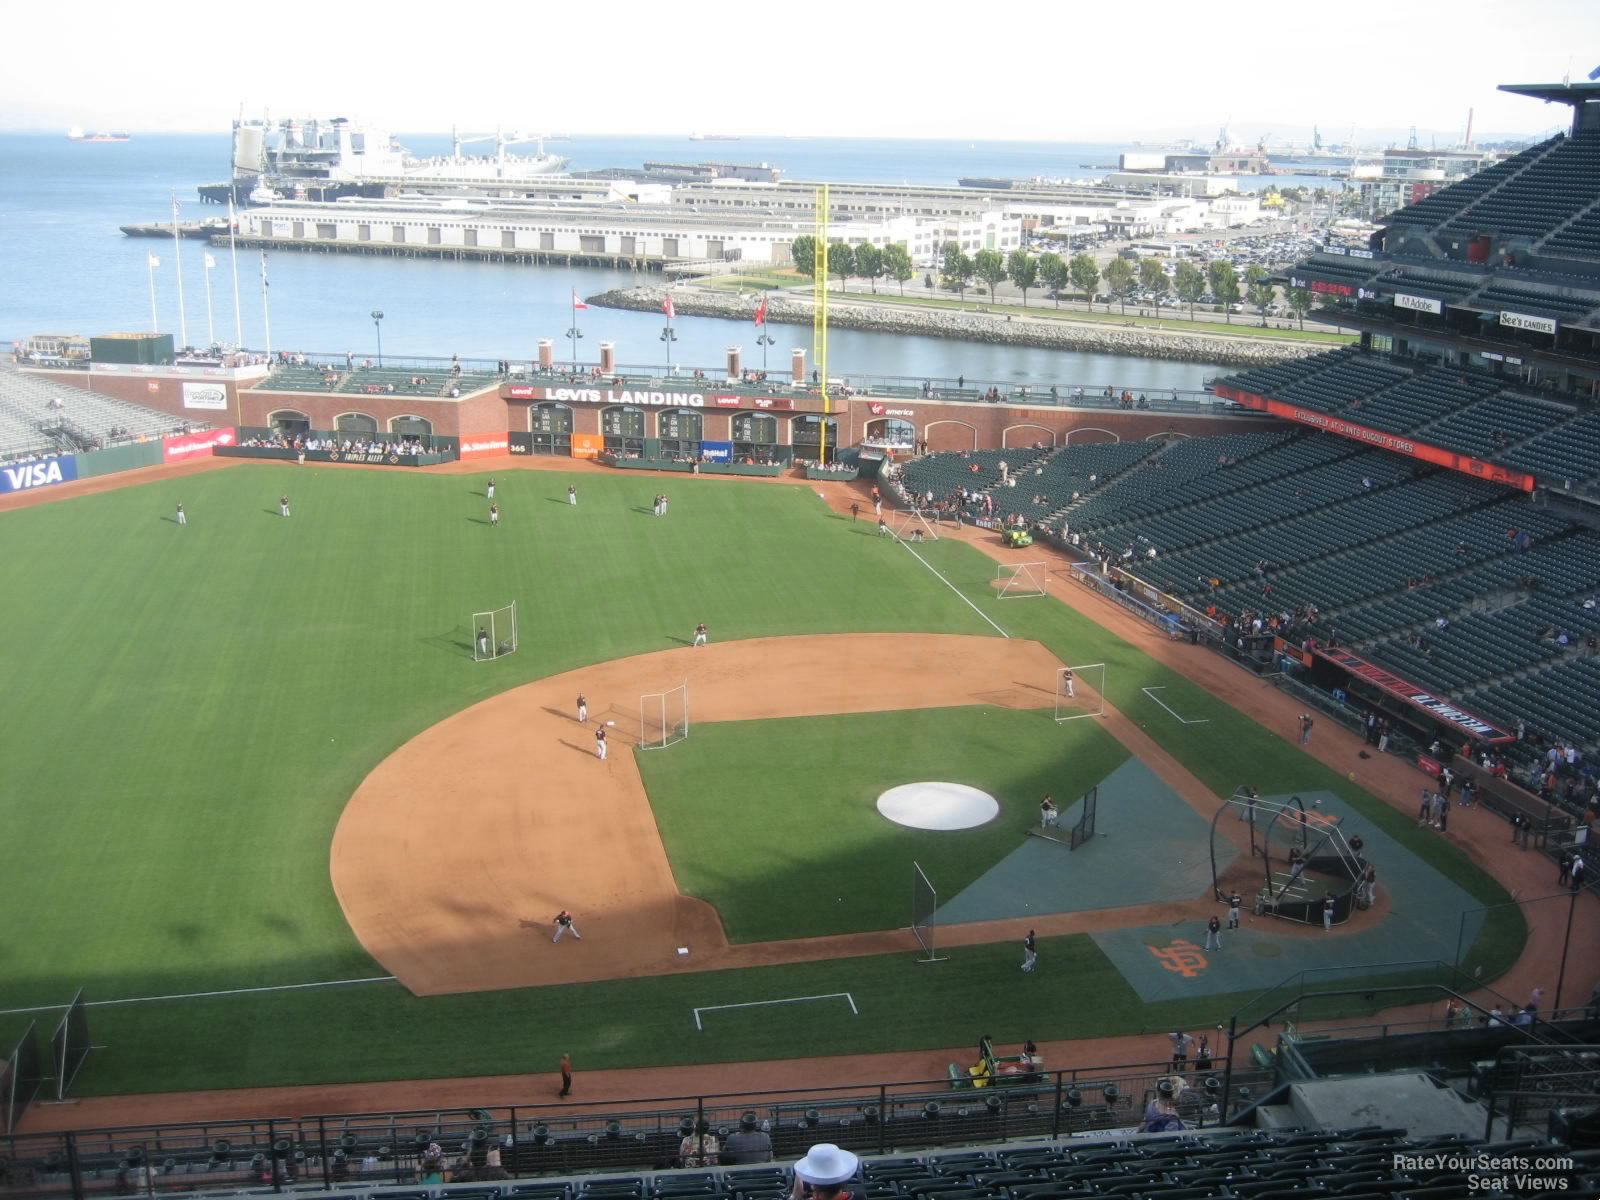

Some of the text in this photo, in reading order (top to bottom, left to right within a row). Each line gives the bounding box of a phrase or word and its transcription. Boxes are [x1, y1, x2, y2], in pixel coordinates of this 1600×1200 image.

[1410, 298, 1432, 311] Adobe
[1501, 312, 1553, 332] See's CANDIES
[607, 389, 704, 407] LANDING
[885, 408, 914, 416] america
[1340, 423, 1361, 437] GIANTS
[1362, 430, 1387, 445] DUGOUT
[1388, 437, 1414, 453] STORES
[344, 452, 384, 463] TRIPLES ALLEY
[511, 445, 526, 453] 365
[3, 460, 63, 490] VISA
[1425, 703, 1493, 735] WELCOME
